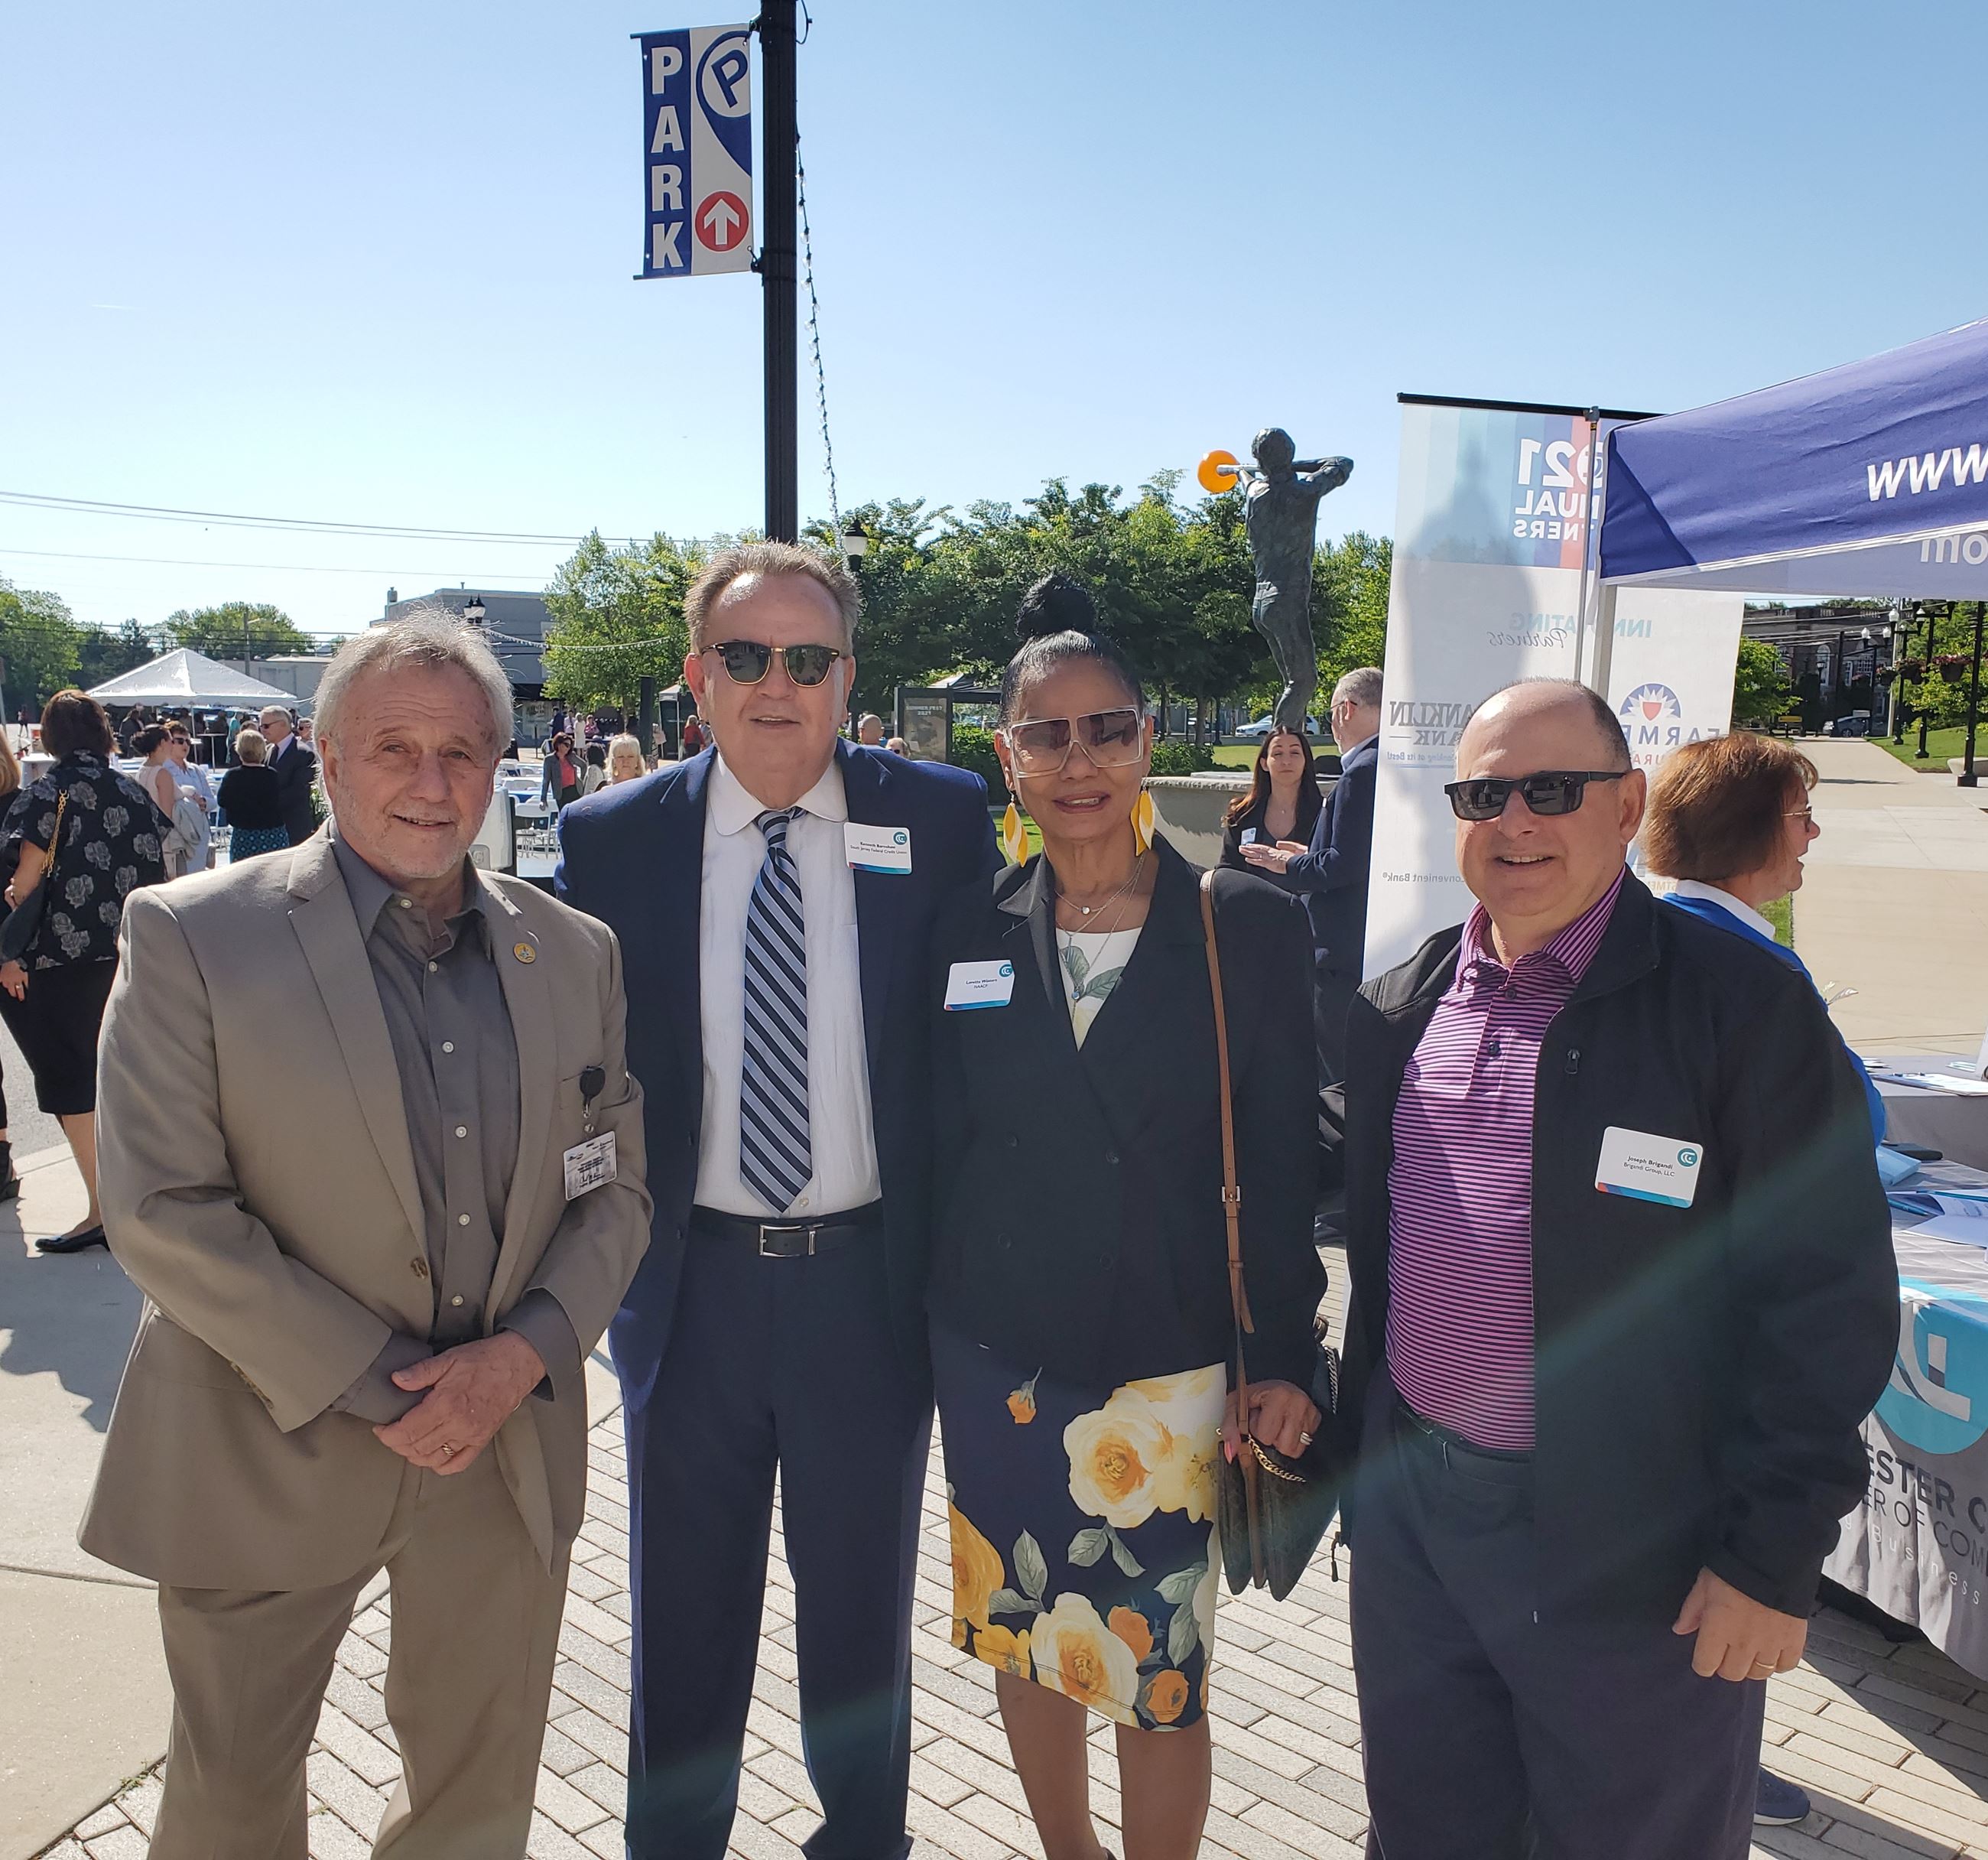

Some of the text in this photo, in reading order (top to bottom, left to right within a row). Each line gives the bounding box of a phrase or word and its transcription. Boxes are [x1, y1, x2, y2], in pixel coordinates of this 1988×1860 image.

[650, 46, 684, 269] PARK
[1623, 1162, 1644, 1170] Brigandi
[1627, 1156, 1673, 1169] Joseph Brigandi
[1933, 1520, 1988, 1578] COM
